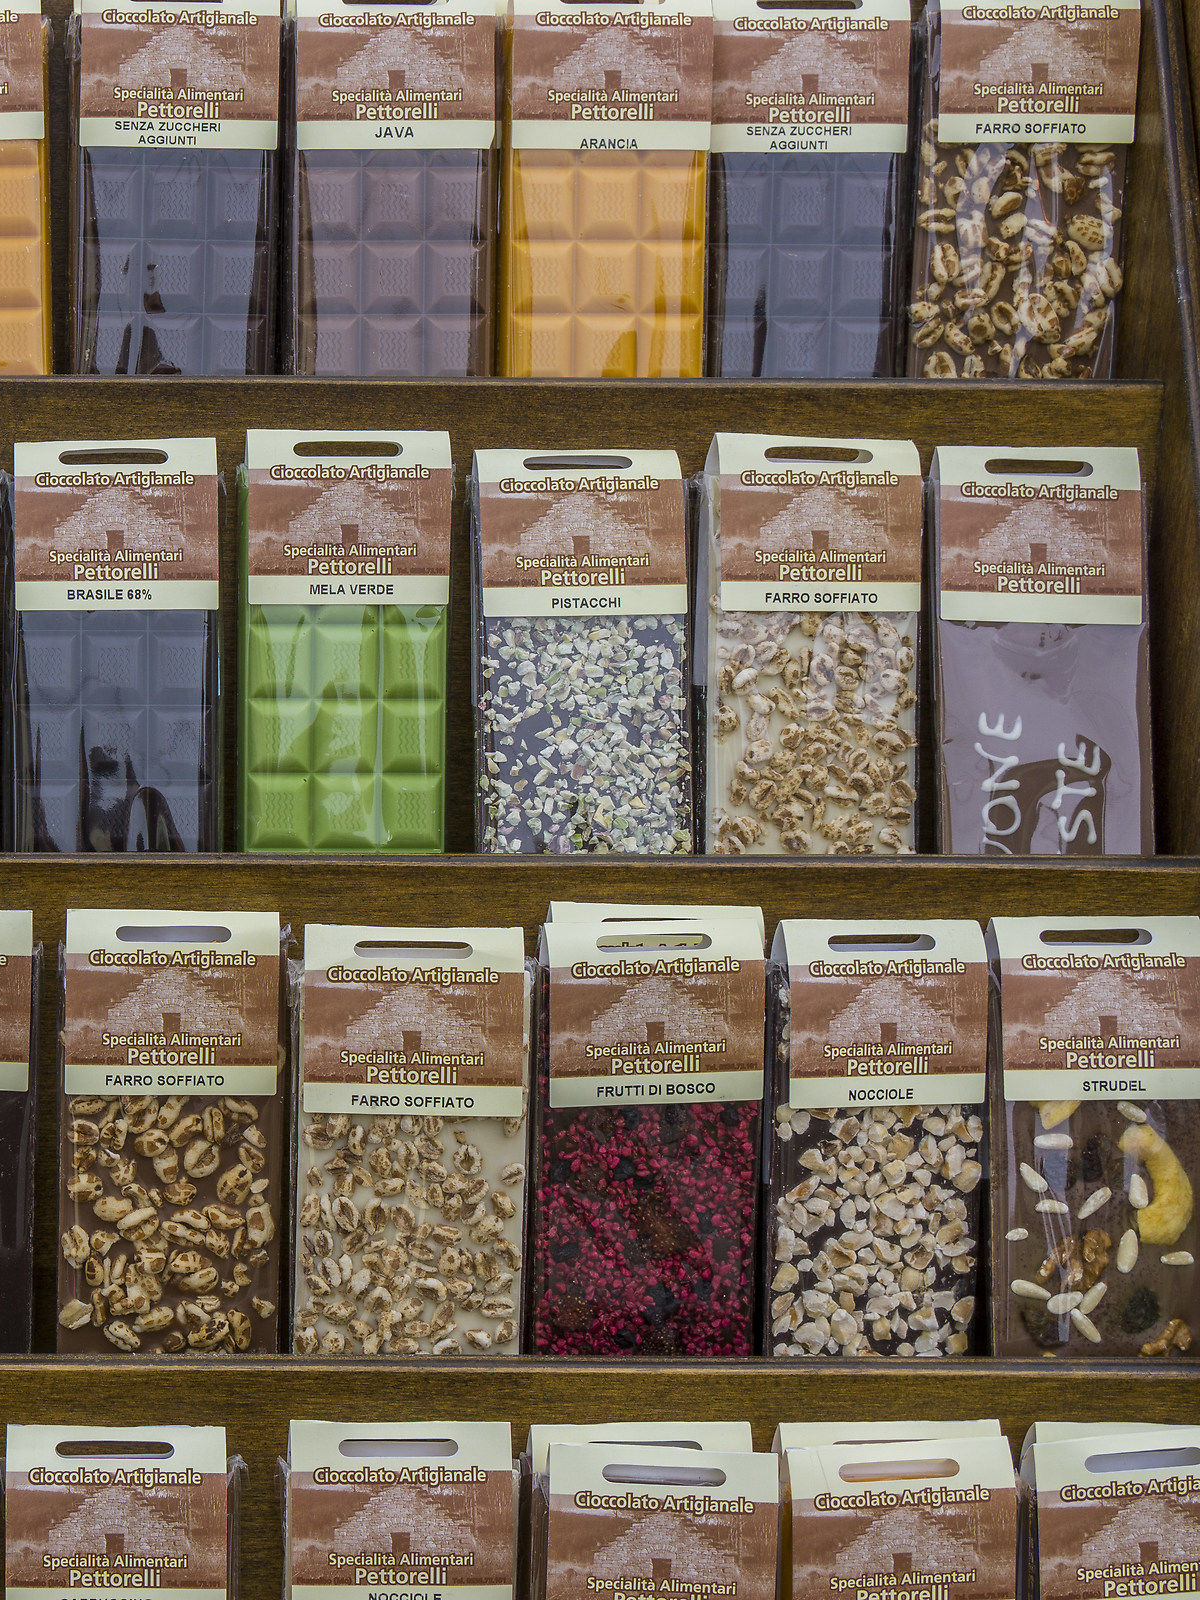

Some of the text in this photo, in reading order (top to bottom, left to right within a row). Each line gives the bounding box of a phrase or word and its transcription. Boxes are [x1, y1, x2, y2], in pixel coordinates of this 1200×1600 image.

[319, 11, 476, 28] Cioccolato Artigianale
[963, 4, 1120, 21] Cioccolato Artigianale
[332, 89, 462, 103] Specialità Alimentari
[974, 82, 1104, 96] Specialità Alimentari
[355, 103, 439, 120] Pettorelli
[997, 96, 1080, 113] Pettorelli
[114, 120, 221, 133] SENZA ZUCCHERI
[374, 126, 414, 139] JAVA
[746, 126, 852, 136] SENZA ZUCCHERI
[975, 122, 1087, 135] FARRO SOFFIATO
[137, 134, 197, 146] AGGIUNTI
[579, 138, 638, 149] ARANCIA
[769, 140, 828, 150] AGGIUNTI
[270, 464, 431, 481] Cioccolato Artigianale
[741, 470, 900, 487] Cioccolato Artigianale
[283, 544, 417, 558] Specialità Alimentari
[755, 550, 887, 564] Specialità Alimentari
[307, 558, 392, 575] Pettorelli
[779, 564, 863, 581] Pettorelli
[67, 588, 152, 601] BRASILE 68%
[309, 584, 394, 595] MELA VERDE
[551, 597, 621, 609] PISTACCHI
[765, 592, 878, 604] FARRO SOFFIATO
[89, 950, 257, 968] Cioccolato Artigianale
[1021, 952, 1190, 971] Cioccolato Artigianale
[571, 956, 741, 979] Cioccolato Artigianale
[102, 1033, 241, 1047] Specialità Alimentari
[1039, 1035, 1180, 1052] Specialità Alimentari
[127, 1048, 216, 1065] Pettorelli
[586, 1039, 726, 1059] Specialità Alimentari
[611, 1054, 700, 1075] Pettorelli
[1065, 1050, 1156, 1069] Pettorelli
[105, 1074, 225, 1087] FARRO SOFFIATO
[1082, 1080, 1147, 1092] STRUDEL
[596, 1082, 716, 1098] FRUTTI DI BOSCO
[848, 1088, 914, 1102] NOCCIOLE
[351, 1094, 475, 1109] FARRO SOFFIATO
[28, 1468, 203, 1487] Cioccolato Artigianale
[313, 1466, 489, 1486] Cioccolato Artigianale
[814, 1485, 991, 1511] Cioccolato Artigianale
[43, 1554, 187, 1569] Specialità Alimentari
[329, 1553, 473, 1567] Specialità Alimentari
[69, 1569, 161, 1587] Pettorelli
[355, 1567, 447, 1585] Pettorelli
